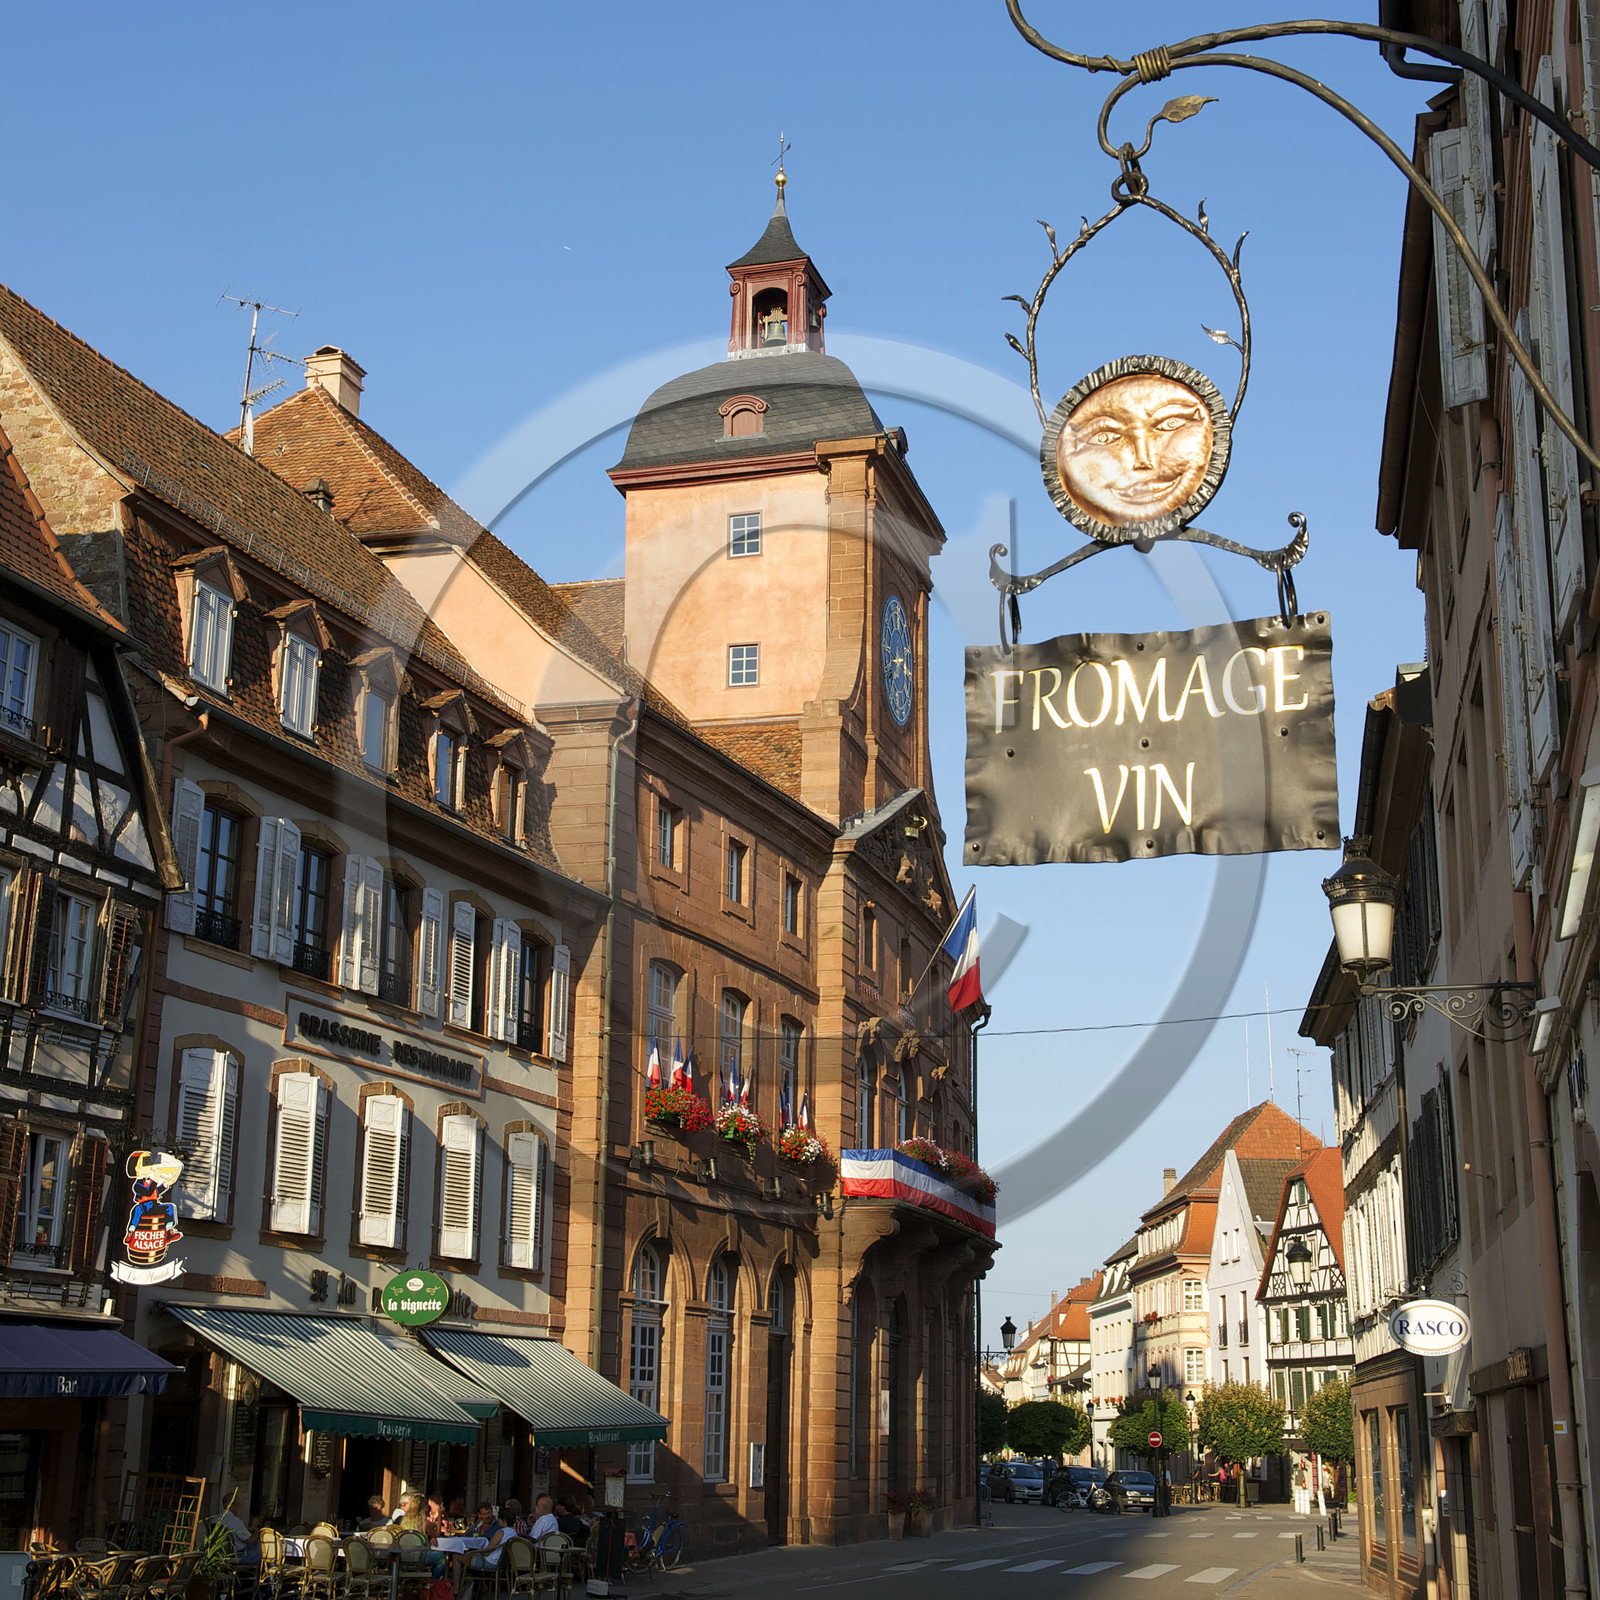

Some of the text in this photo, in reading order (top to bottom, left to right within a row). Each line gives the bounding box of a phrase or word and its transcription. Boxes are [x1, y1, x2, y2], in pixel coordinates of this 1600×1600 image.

[990, 645, 1308, 734] FROMAGE
[1083, 761, 1196, 834] VIN
[299, 1012, 474, 1083] BRASSERIE RESTAURANT
[133, 1239, 164, 1250] ALSACE
[134, 1230, 165, 1241] FISCHER
[387, 1298, 399, 1312] la
[401, 1297, 443, 1315] vignette
[1397, 1319, 1463, 1336] RASCO
[56, 1375, 78, 1394] Bar
[377, 1420, 411, 1437] Brasserie
